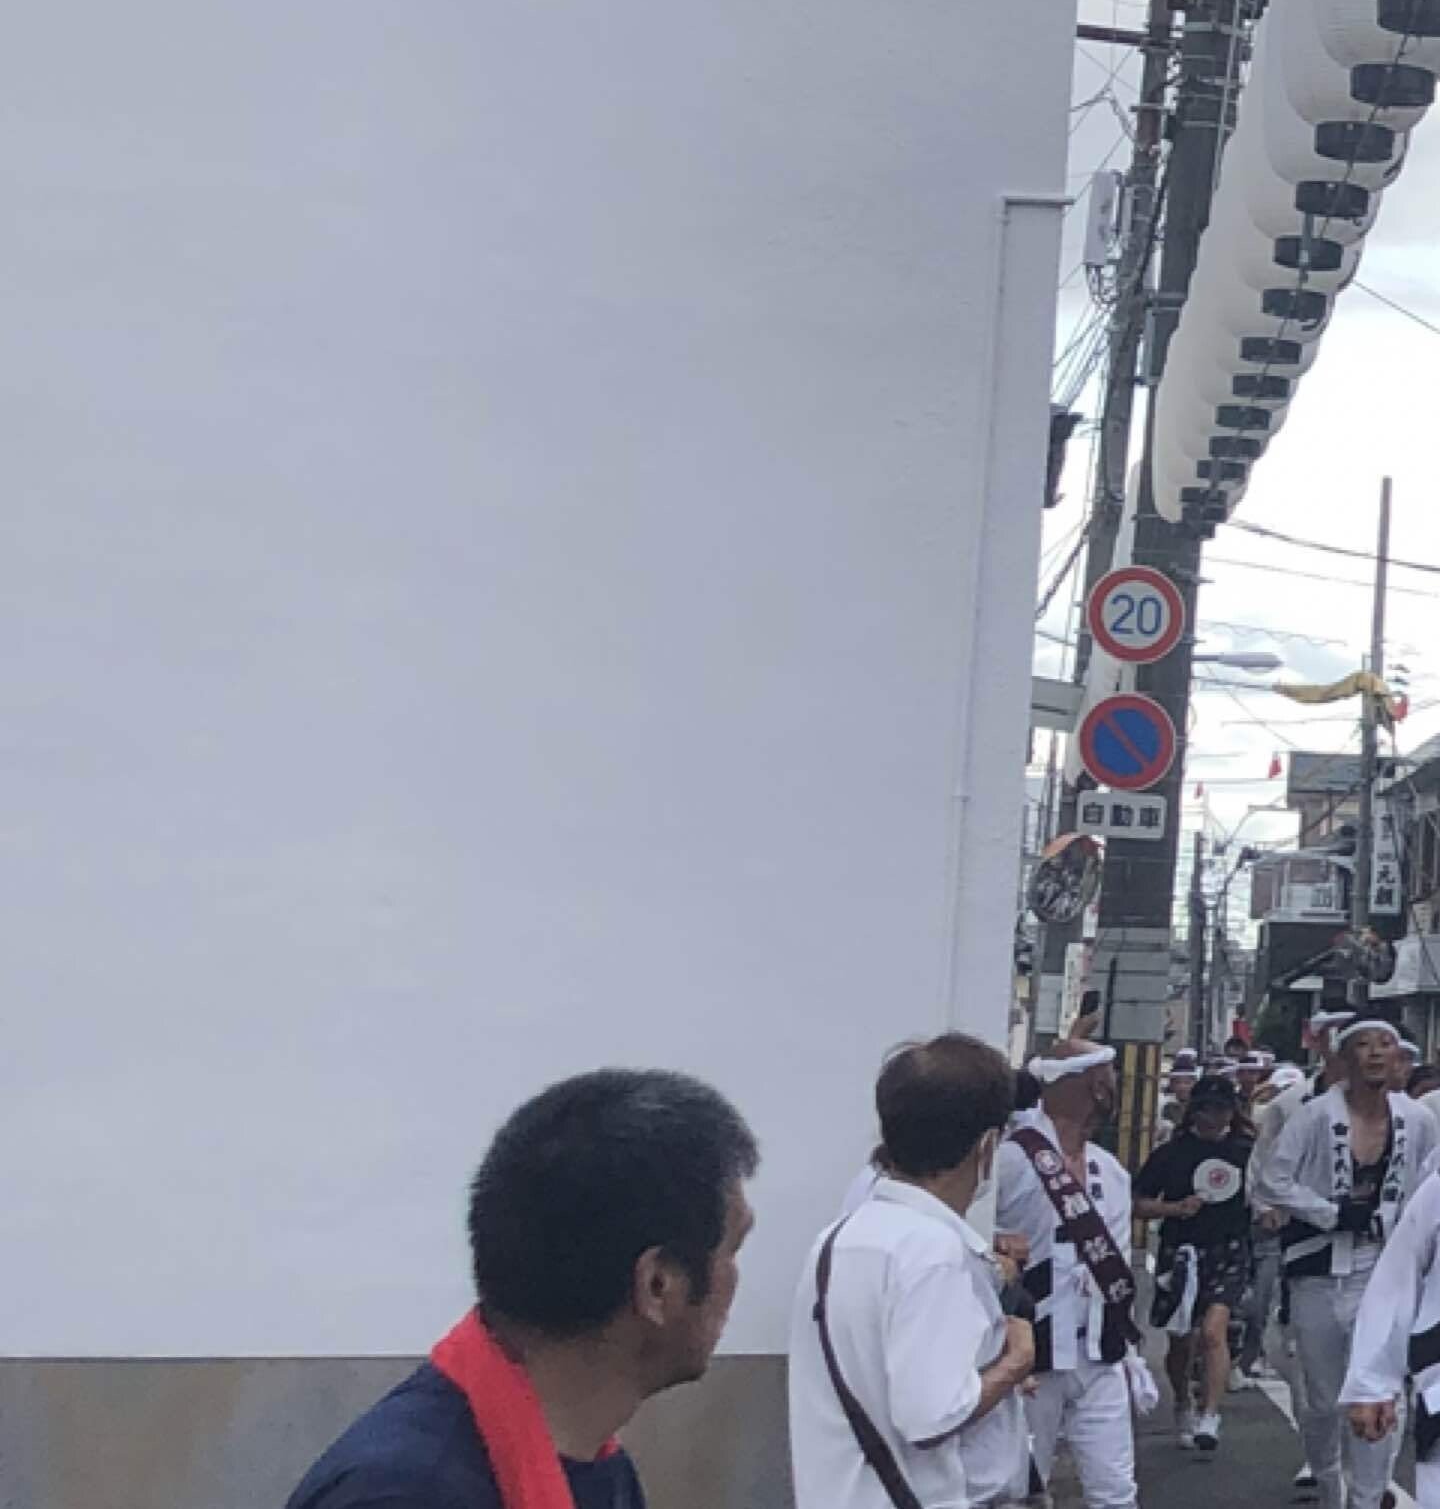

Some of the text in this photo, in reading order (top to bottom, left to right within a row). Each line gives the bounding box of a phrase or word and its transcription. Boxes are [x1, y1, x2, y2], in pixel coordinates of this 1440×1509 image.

[1109, 593, 1161, 636] 20
[1083, 802, 1161, 829] 自動車
